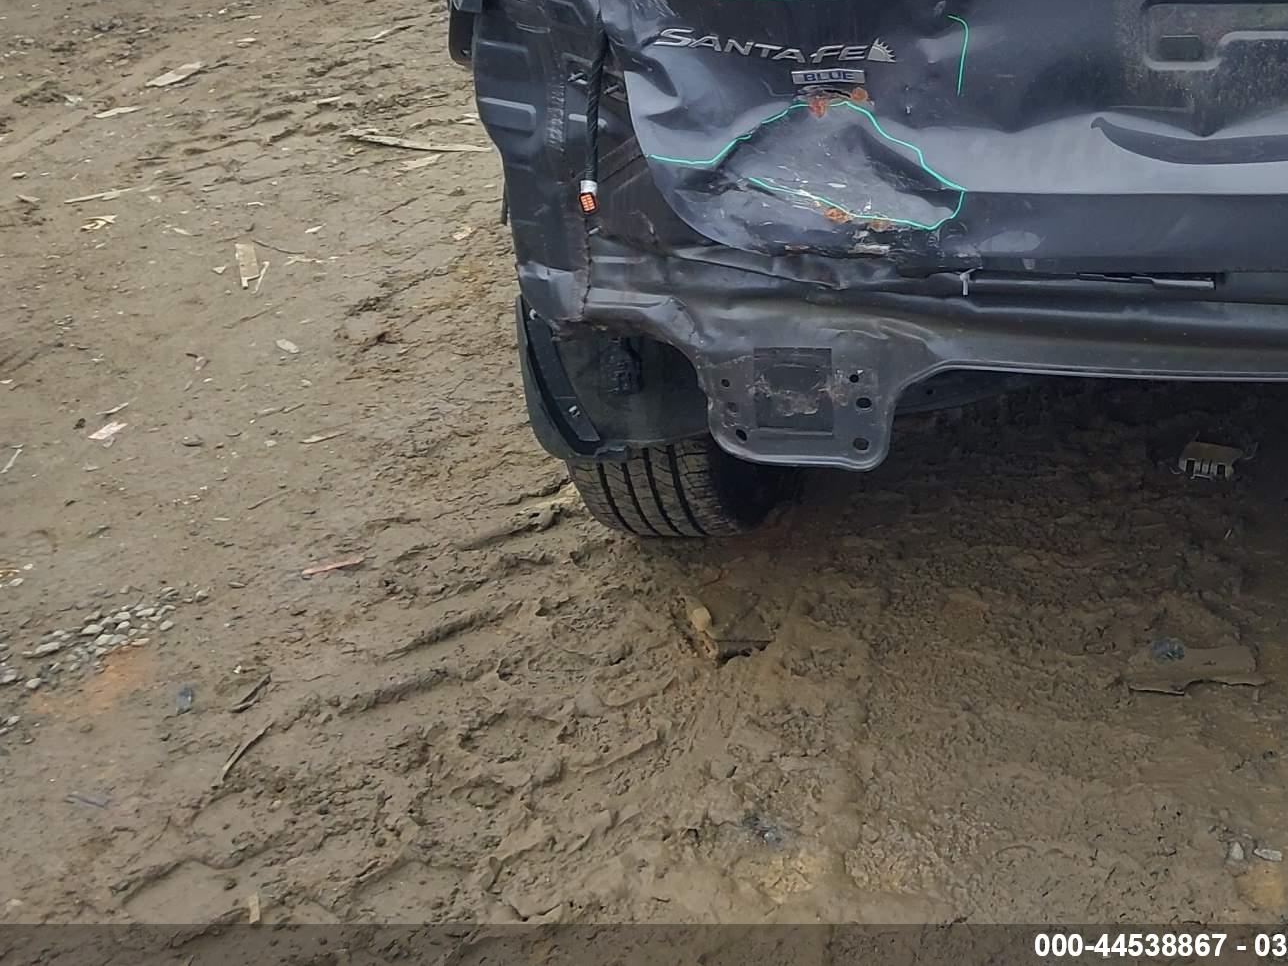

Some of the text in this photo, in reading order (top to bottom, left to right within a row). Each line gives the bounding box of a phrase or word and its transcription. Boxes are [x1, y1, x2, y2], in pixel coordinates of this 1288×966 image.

[653, 28, 869, 64] SANTA FE
[803, 71, 856, 83] BLUE
